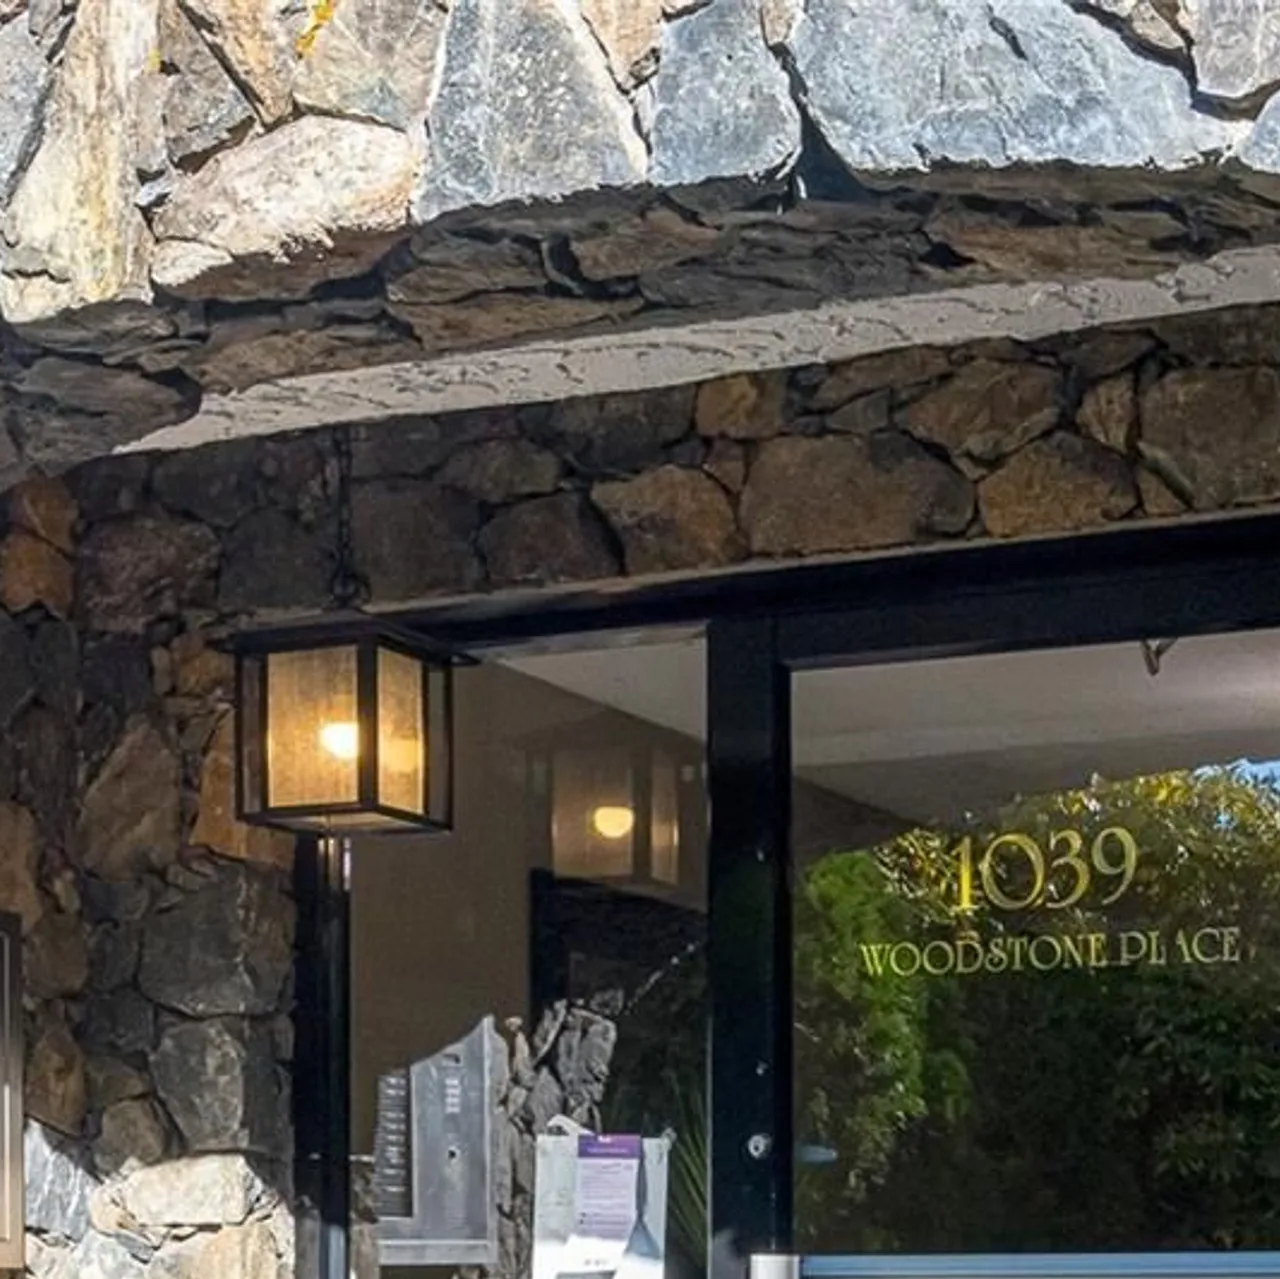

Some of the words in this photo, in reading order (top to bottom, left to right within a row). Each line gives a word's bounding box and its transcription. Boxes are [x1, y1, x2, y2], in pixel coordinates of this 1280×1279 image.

[947, 826, 1138, 912] 1039
[859, 933, 1108, 977] WOODSTONE
[1119, 926, 1240, 966] PLACE
